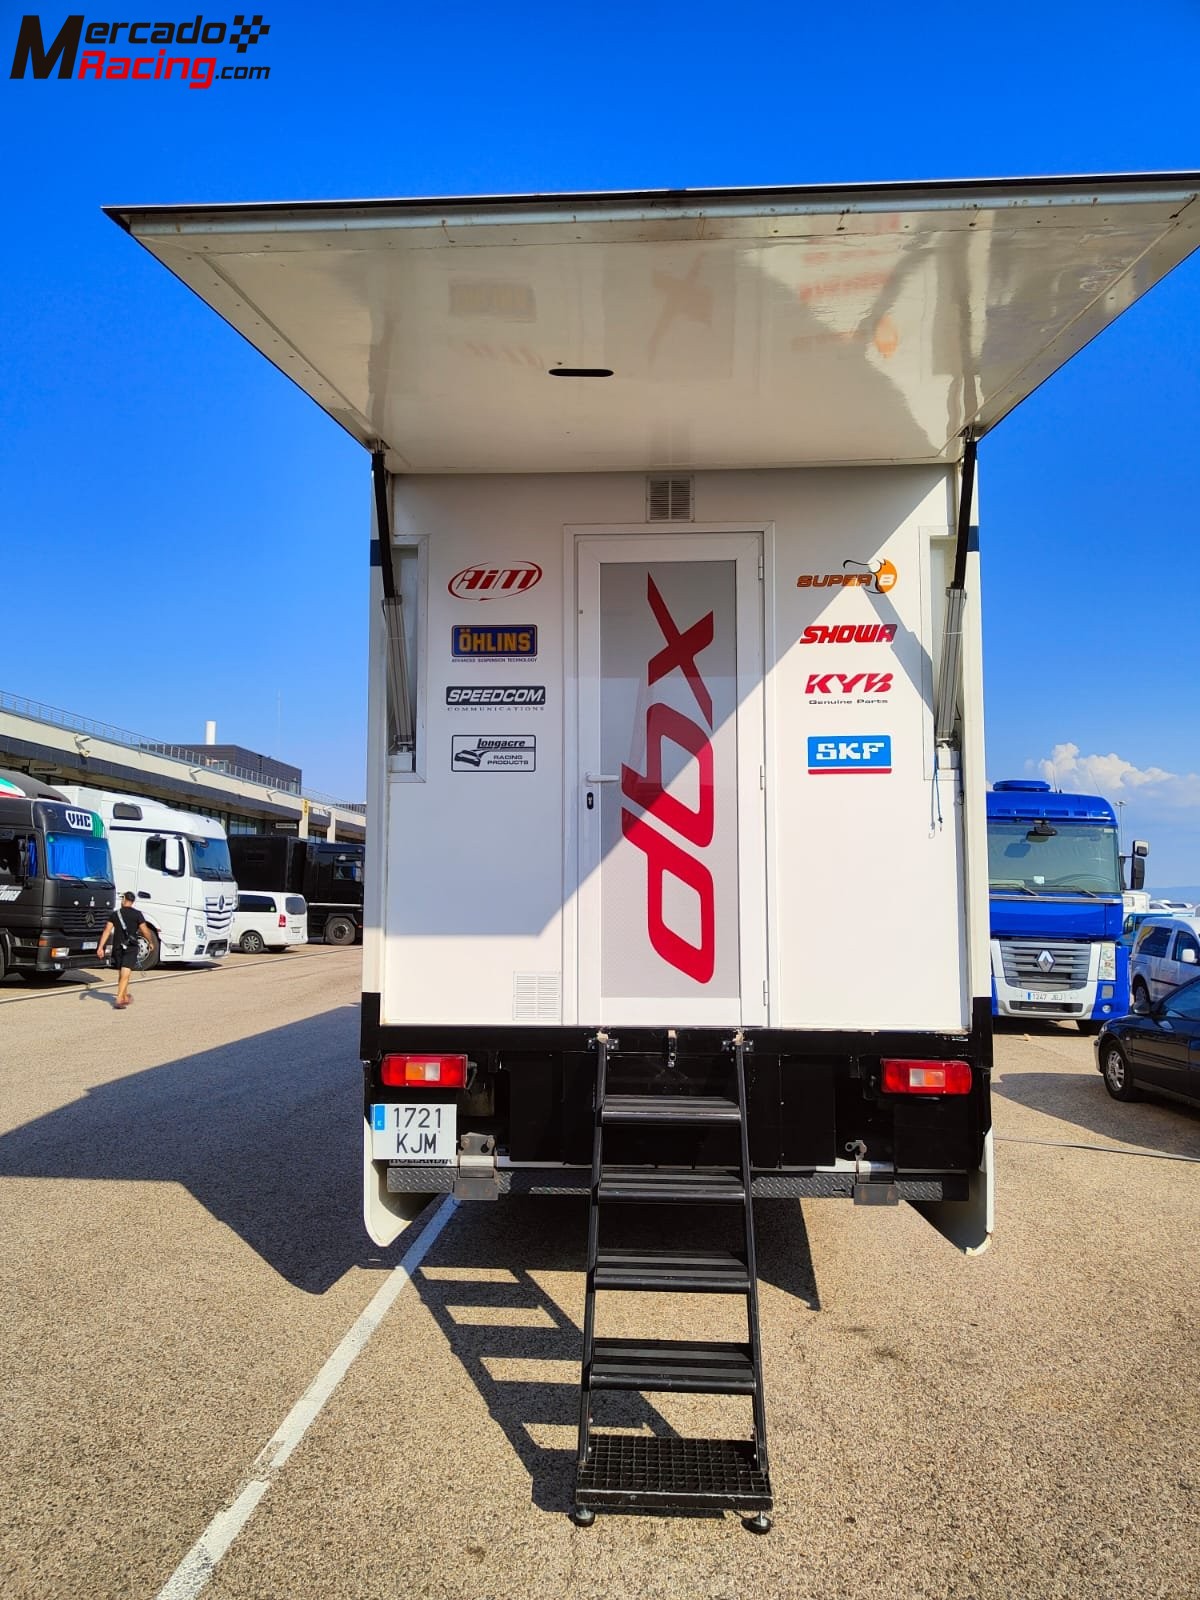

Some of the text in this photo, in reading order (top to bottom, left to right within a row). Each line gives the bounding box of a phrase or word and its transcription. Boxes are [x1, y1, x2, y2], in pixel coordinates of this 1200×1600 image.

[797, 574, 872, 587] SUPER
[459, 629, 531, 651] ÖHLINS
[799, 624, 898, 644] SHOWA
[805, 673, 894, 694] KYB
[816, 743, 885, 760] SKF
[67, 812, 91, 827] VHC
[394, 1107, 442, 1129] 1721
[396, 1133, 437, 1154] KJM
